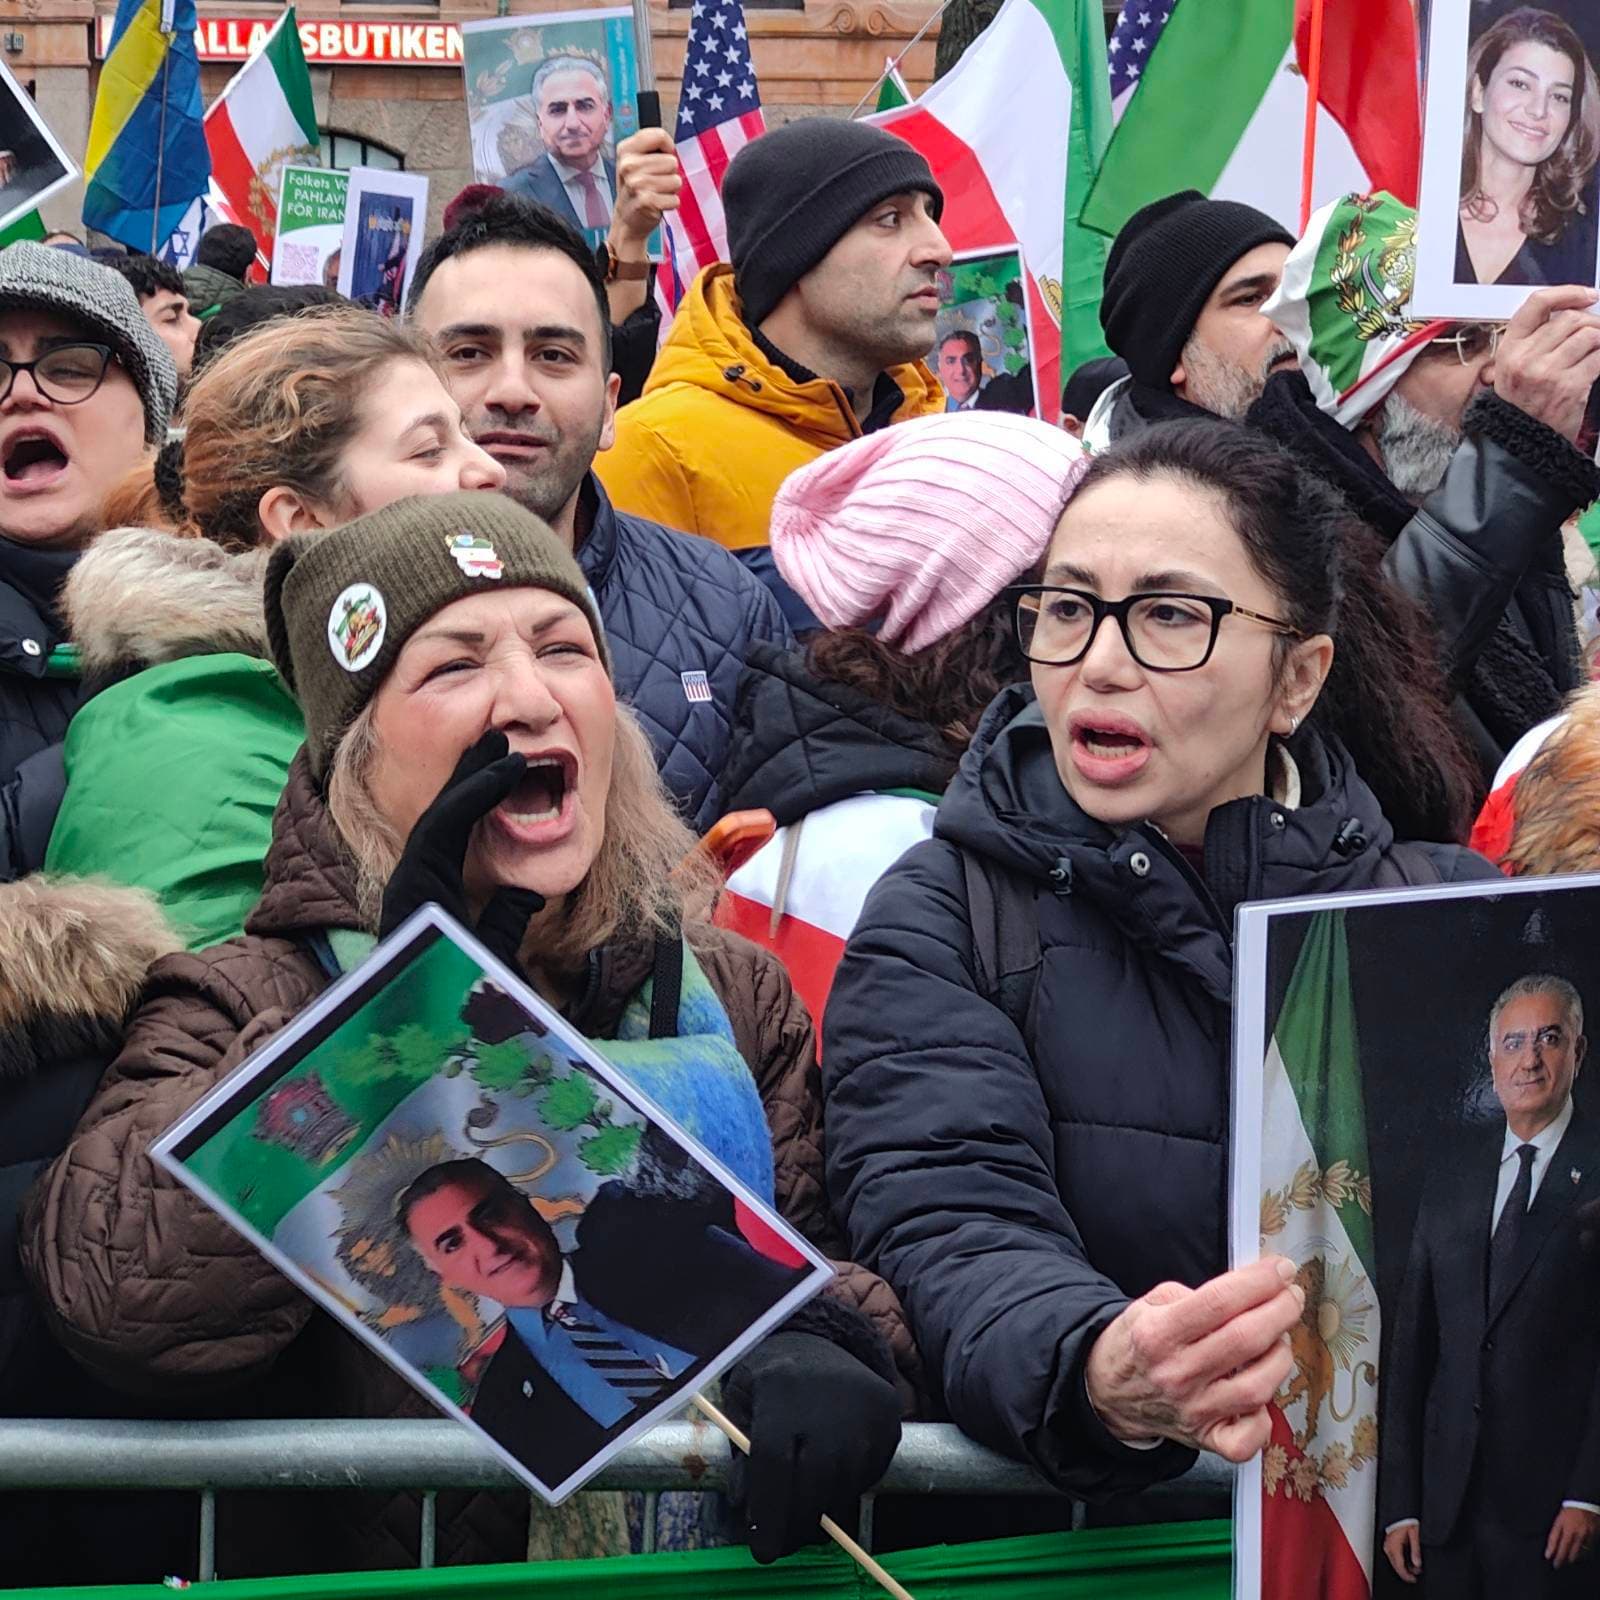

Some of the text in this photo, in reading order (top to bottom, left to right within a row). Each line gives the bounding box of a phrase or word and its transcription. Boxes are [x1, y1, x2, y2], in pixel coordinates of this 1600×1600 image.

[289, 172, 330, 190] Folkets
[294, 188, 345, 206] PAHLAVI
[287, 202, 345, 221] FÖR IRAN
